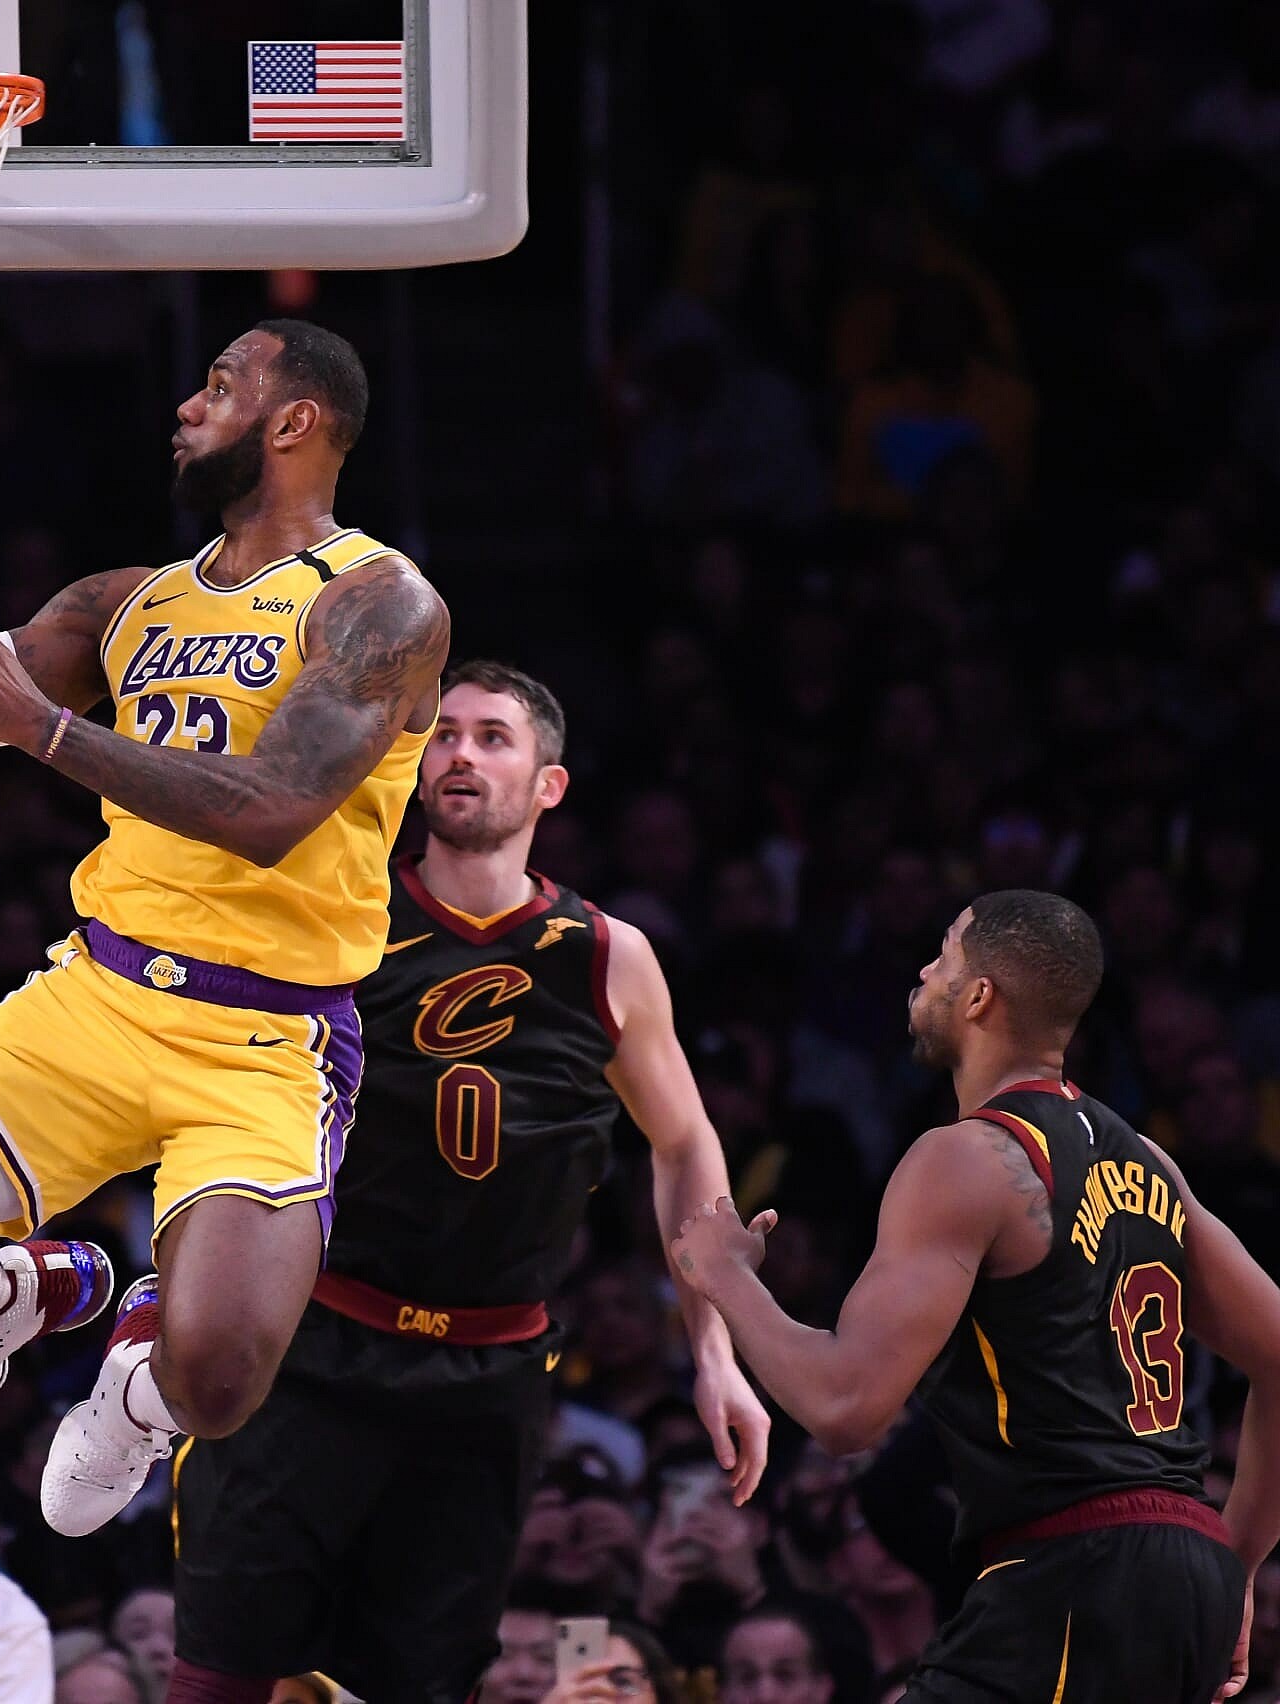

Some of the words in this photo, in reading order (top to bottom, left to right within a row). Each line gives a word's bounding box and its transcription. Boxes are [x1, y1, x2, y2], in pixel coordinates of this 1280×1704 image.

[252, 596, 295, 616] wish
[119, 623, 287, 691] LAKERS
[47, 718, 68, 755] PROMISE
[144, 959, 187, 986] LAKERS
[414, 964, 533, 1059] C
[436, 1063, 501, 1181] 0
[1070, 1160, 1188, 1265] THOMPSON
[397, 1305, 451, 1337] CAVS
[1110, 1261, 1184, 1437] 13
